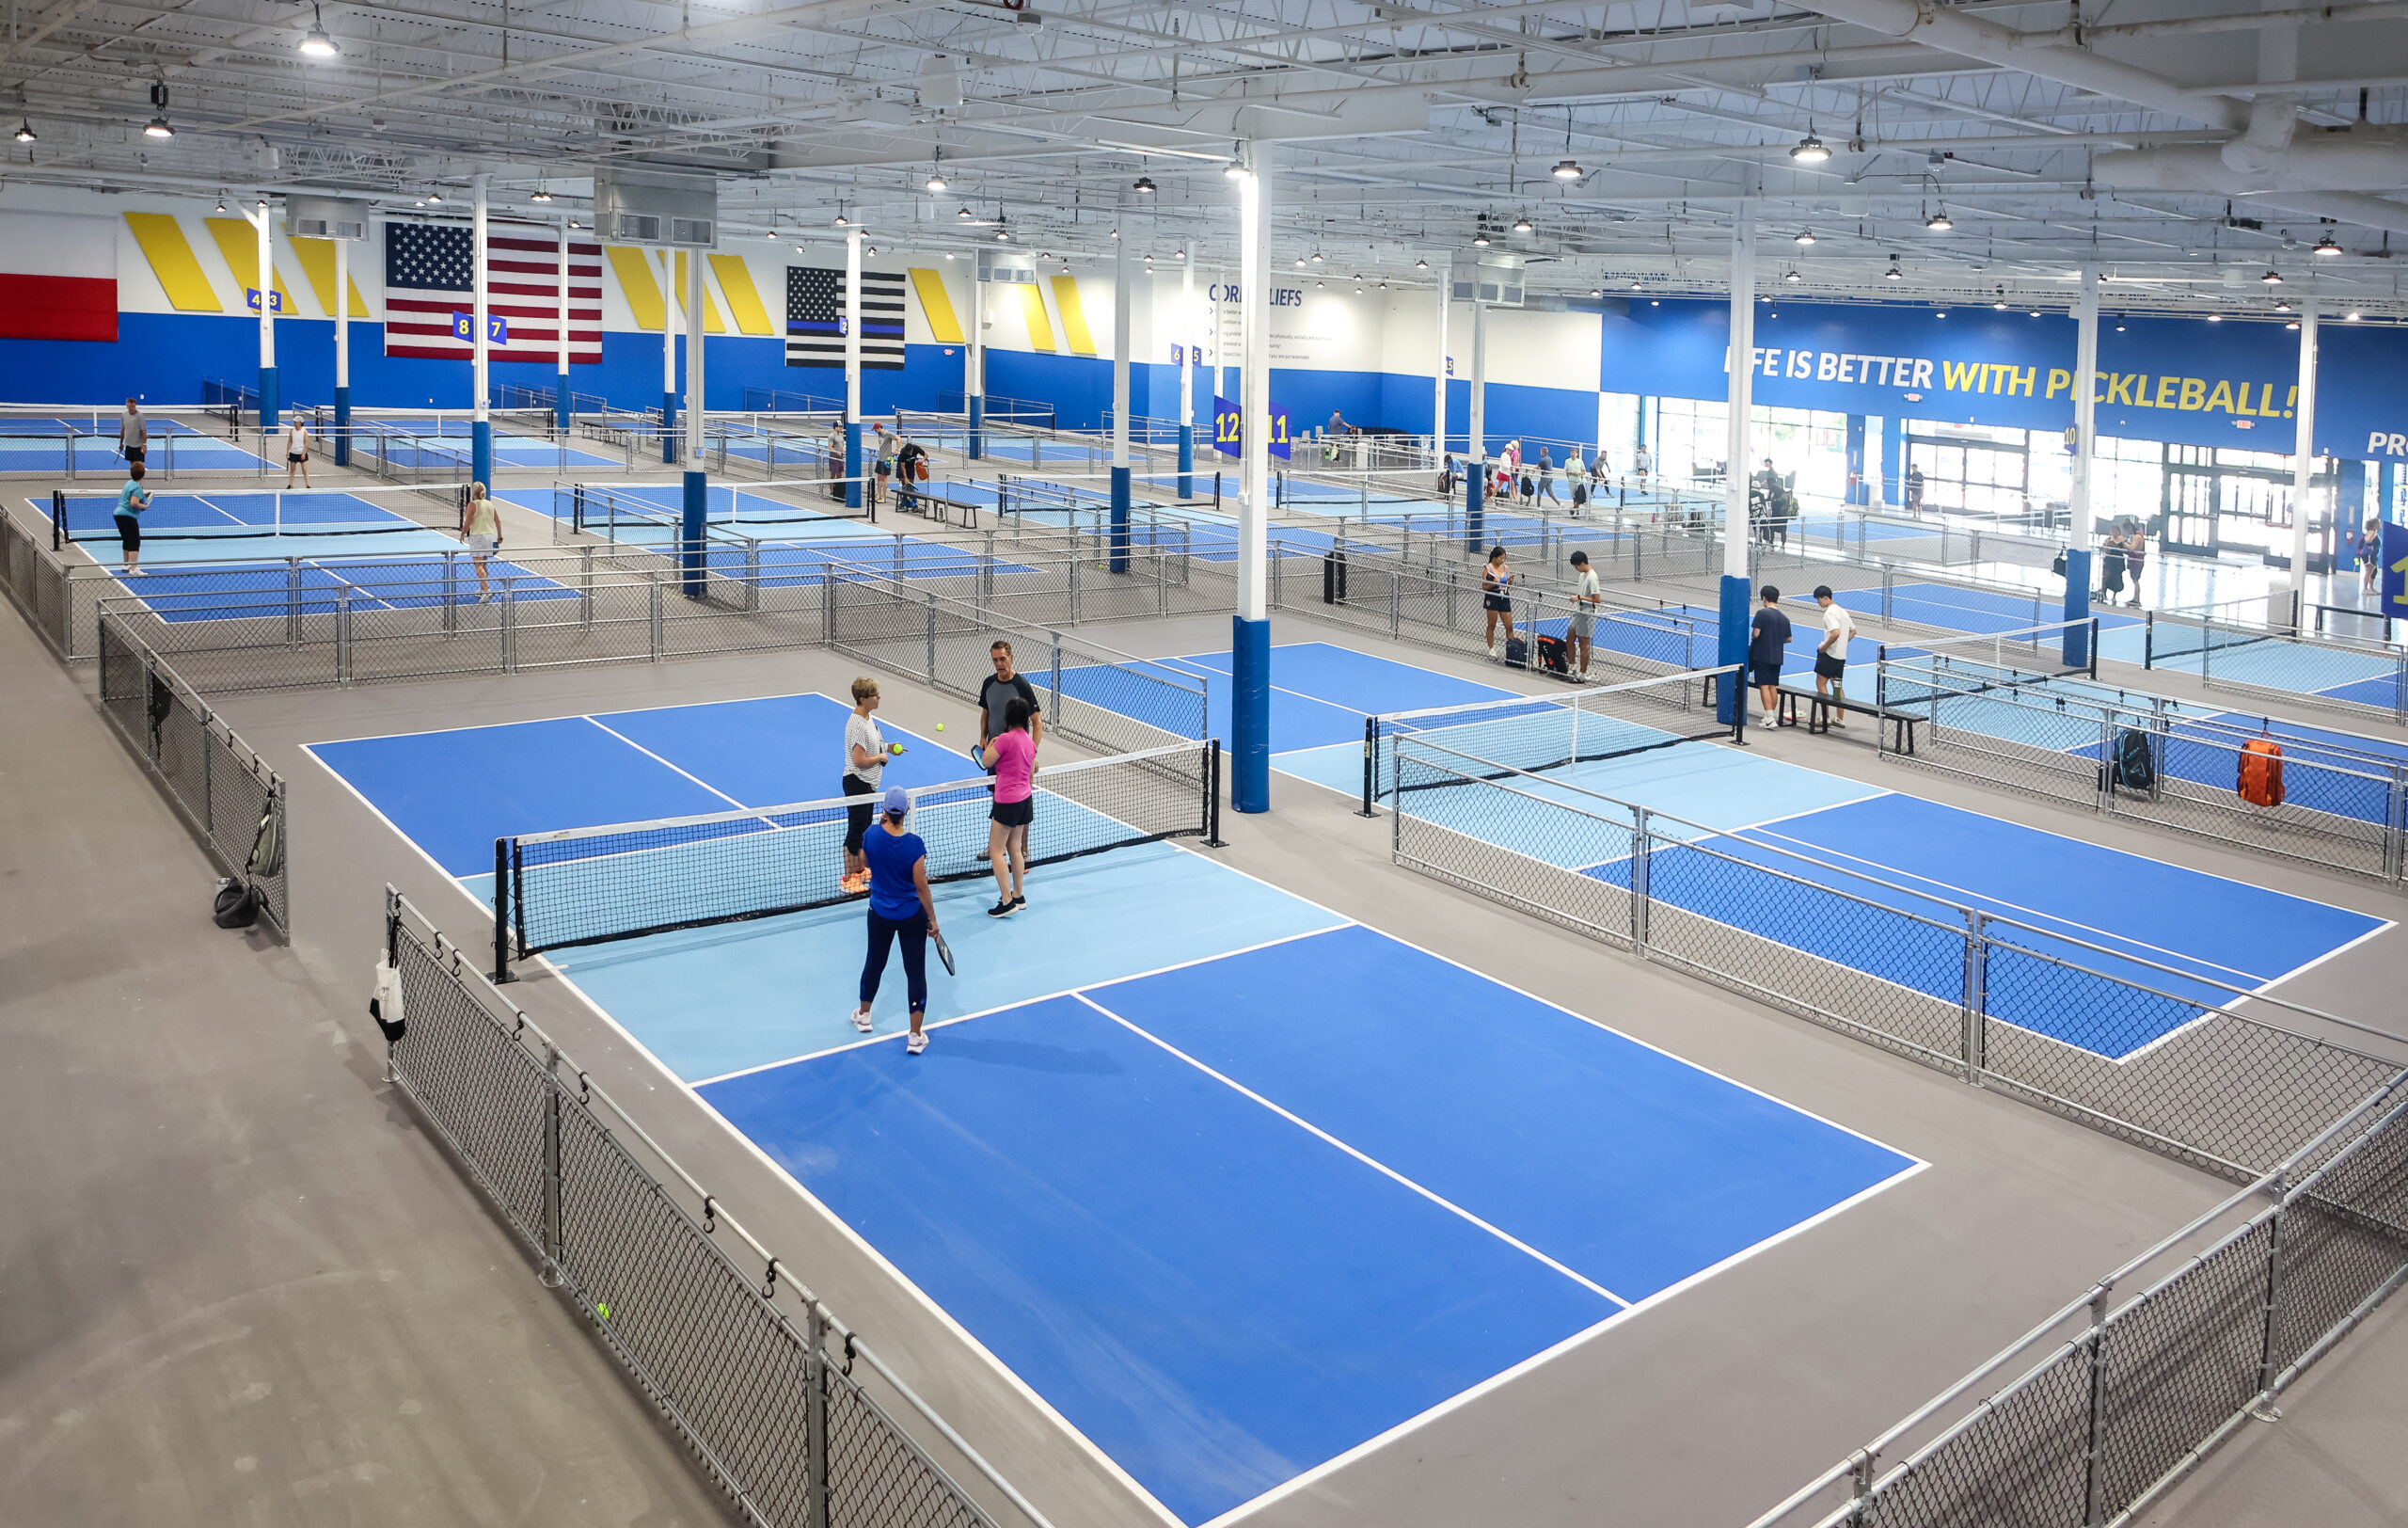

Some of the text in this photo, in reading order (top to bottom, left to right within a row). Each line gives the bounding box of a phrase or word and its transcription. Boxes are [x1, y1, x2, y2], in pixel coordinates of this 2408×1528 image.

[252, 294, 261, 305] 4
[270, 294, 277, 306] 3
[1270, 288, 1302, 307] LIEFS
[459, 319, 469, 335] 8
[491, 321, 501, 337] 7
[843, 321, 848, 331] 2
[1174, 349, 1180, 360] 6
[1194, 350, 1199, 362] 5
[1785, 349, 1814, 380] IS
[1816, 352, 1934, 390] BETTER
[1942, 359, 2036, 397] WITH
[1215, 412, 1240, 442] 12
[2064, 426, 2077, 445] 10
[2367, 431, 2408, 456] PR
